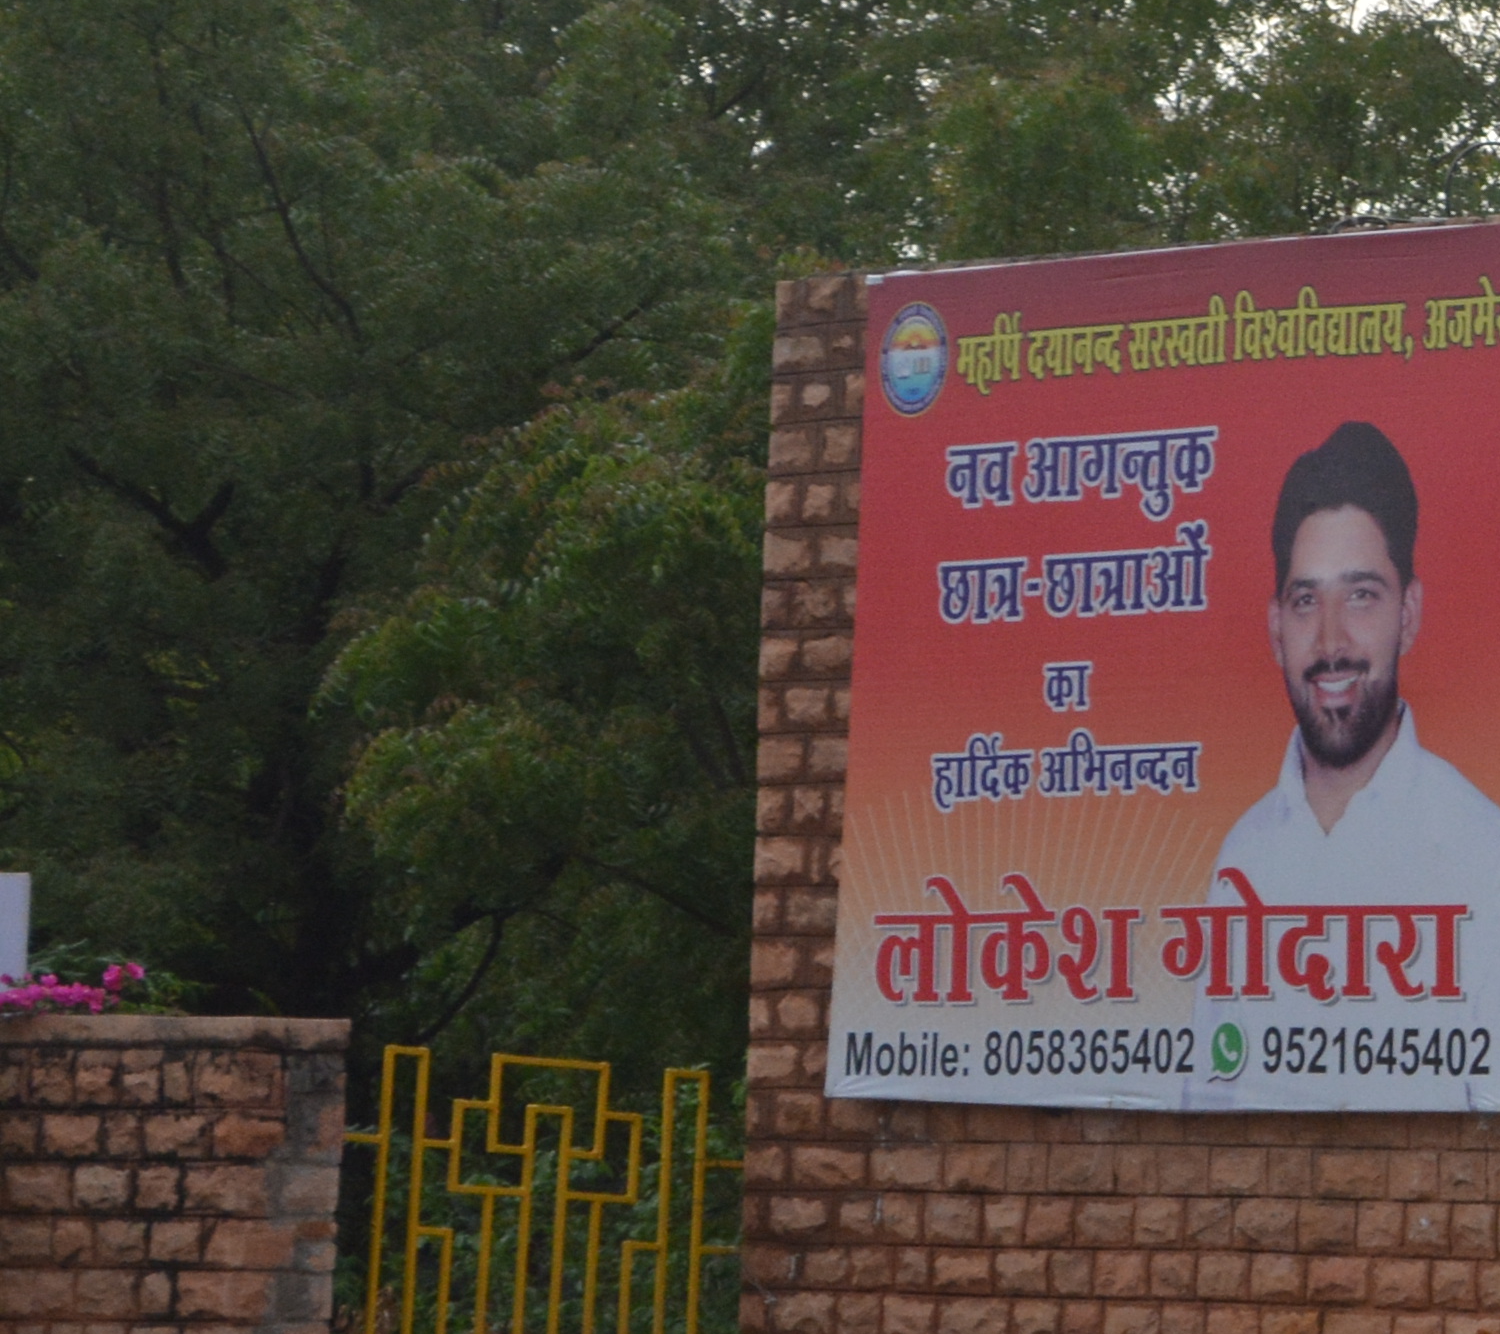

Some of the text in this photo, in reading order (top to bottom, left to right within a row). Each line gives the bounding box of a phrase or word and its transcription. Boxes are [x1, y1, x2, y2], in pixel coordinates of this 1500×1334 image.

[956, 312, 1024, 396] महर्षि
[1028, 323, 1126, 380] दयानन्द
[1129, 294, 1229, 372] सरस्वती
[947, 425, 1218, 521] नव आगन्तुक
[1043, 661, 1093, 712] का
[931, 727, 1203, 813] हार्दिक अभिनन्दन
[874, 867, 1470, 1004] लोकेश गोदारा
[845, 1025, 1492, 1077] Mobile: 8058365402 9521645402
